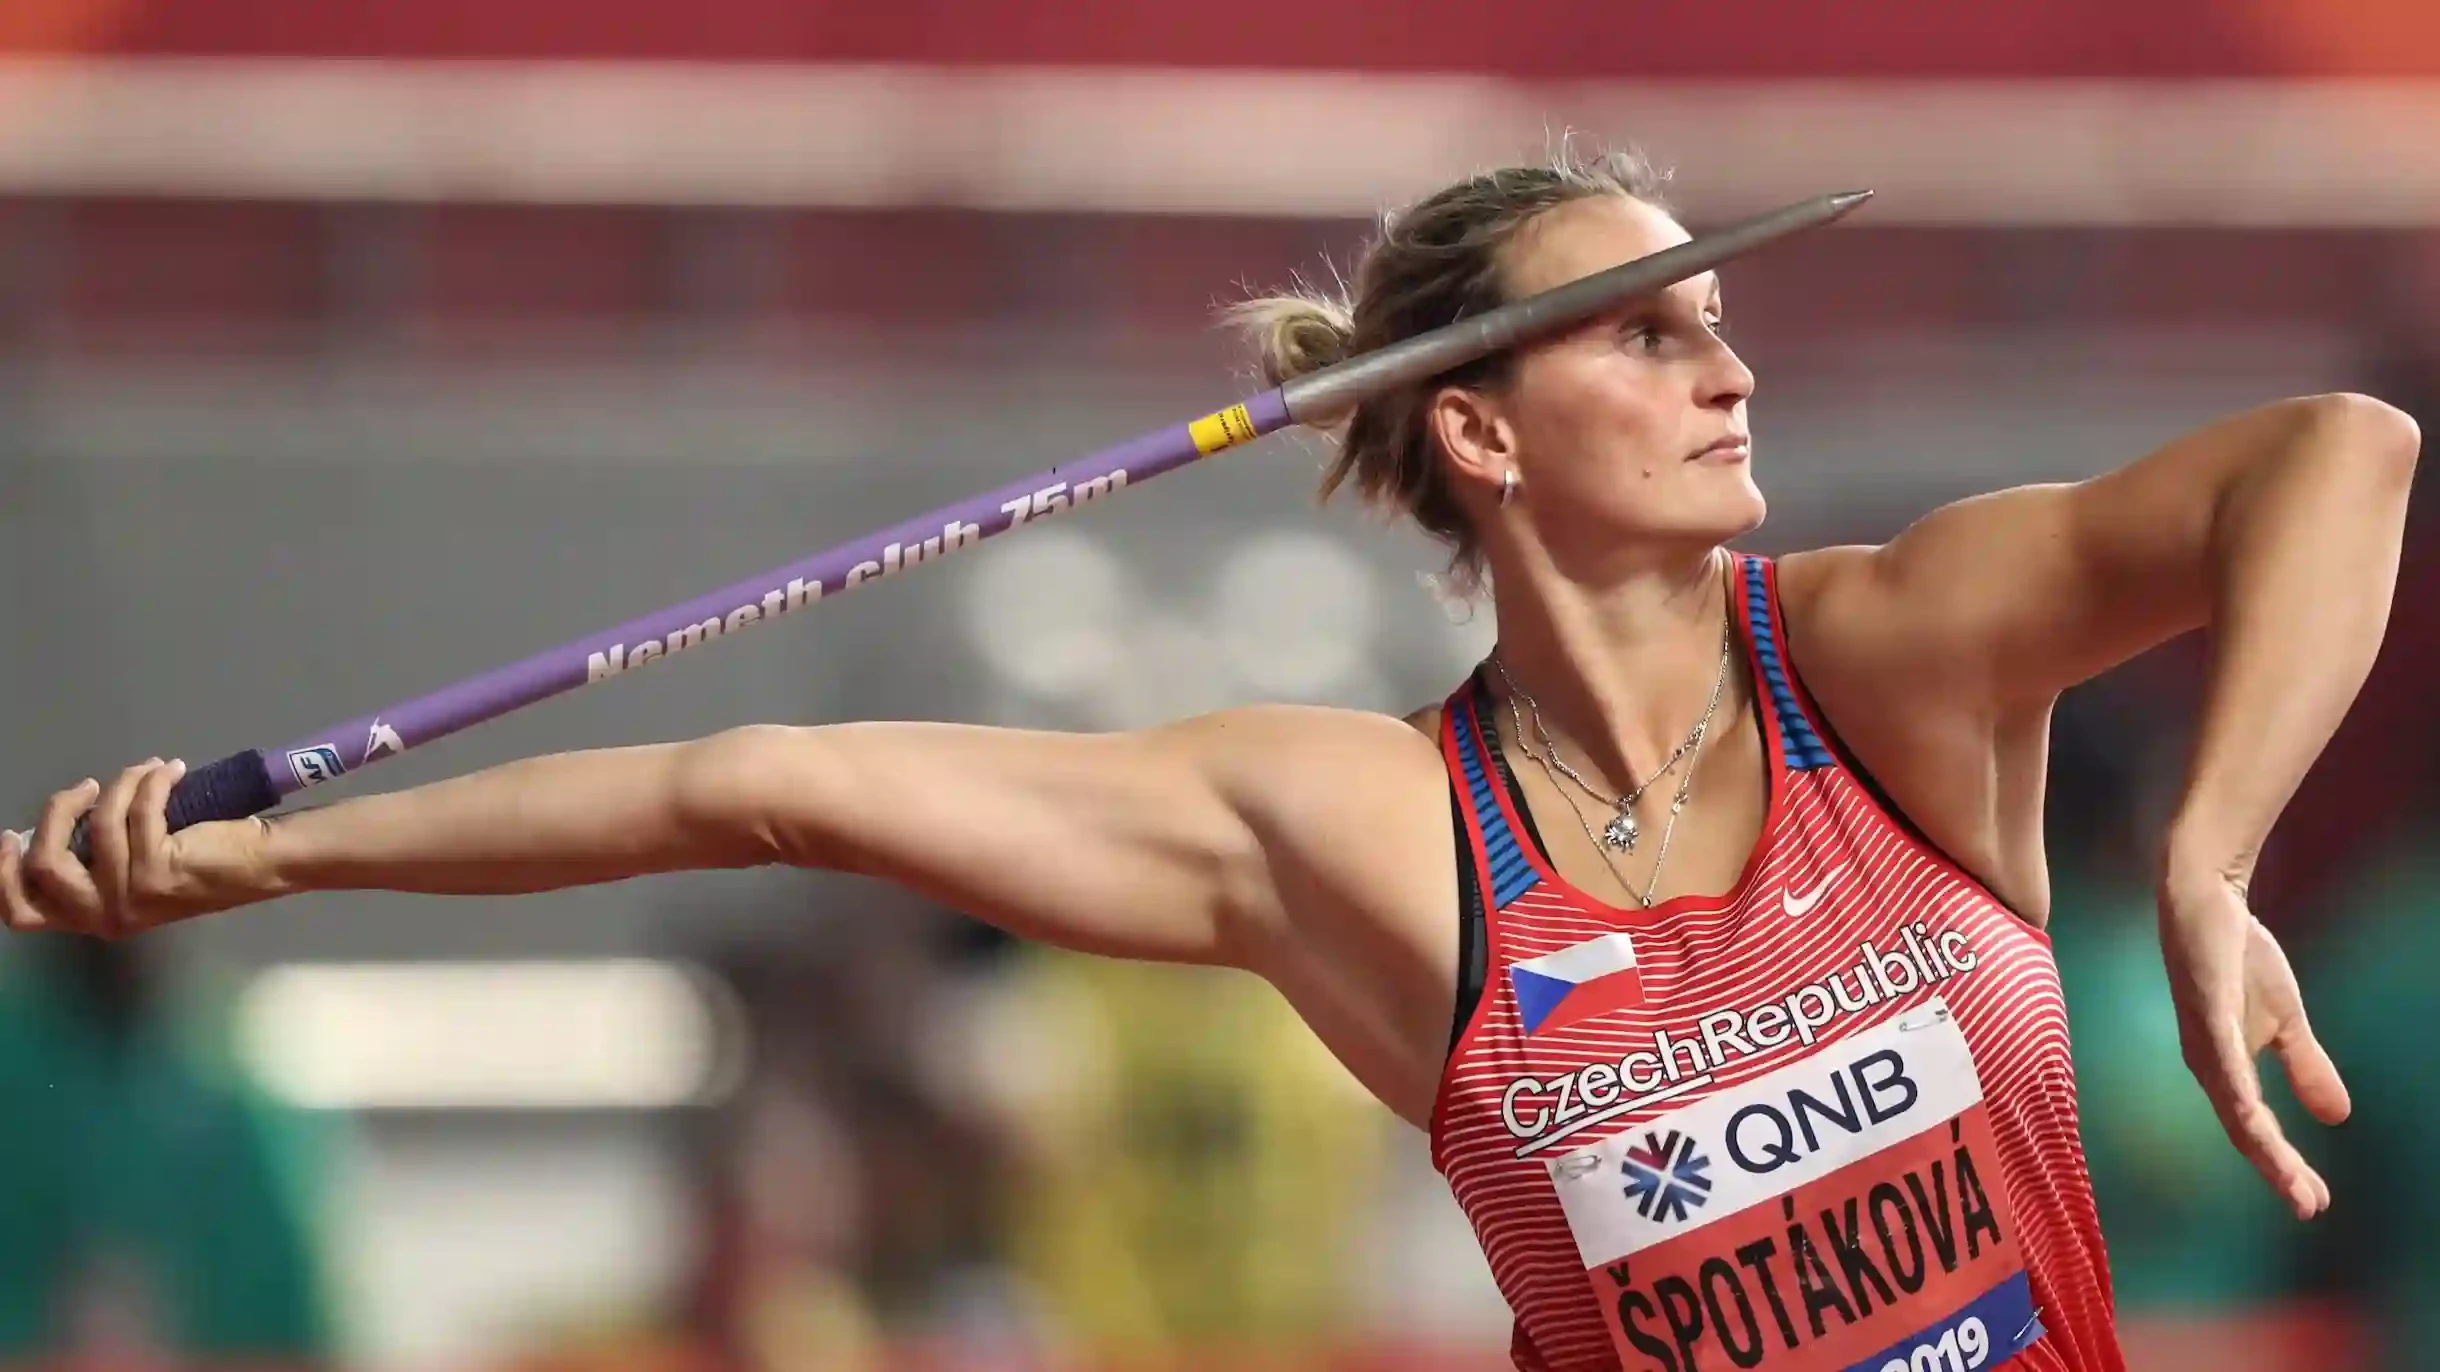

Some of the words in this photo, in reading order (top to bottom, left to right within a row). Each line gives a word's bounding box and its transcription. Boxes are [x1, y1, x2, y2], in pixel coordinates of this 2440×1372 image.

[587, 577, 823, 684] Nemeth
[1724, 1048, 1919, 1174] QNB
[1607, 1119, 2002, 1372] ŠPOTÁKOVÁ
